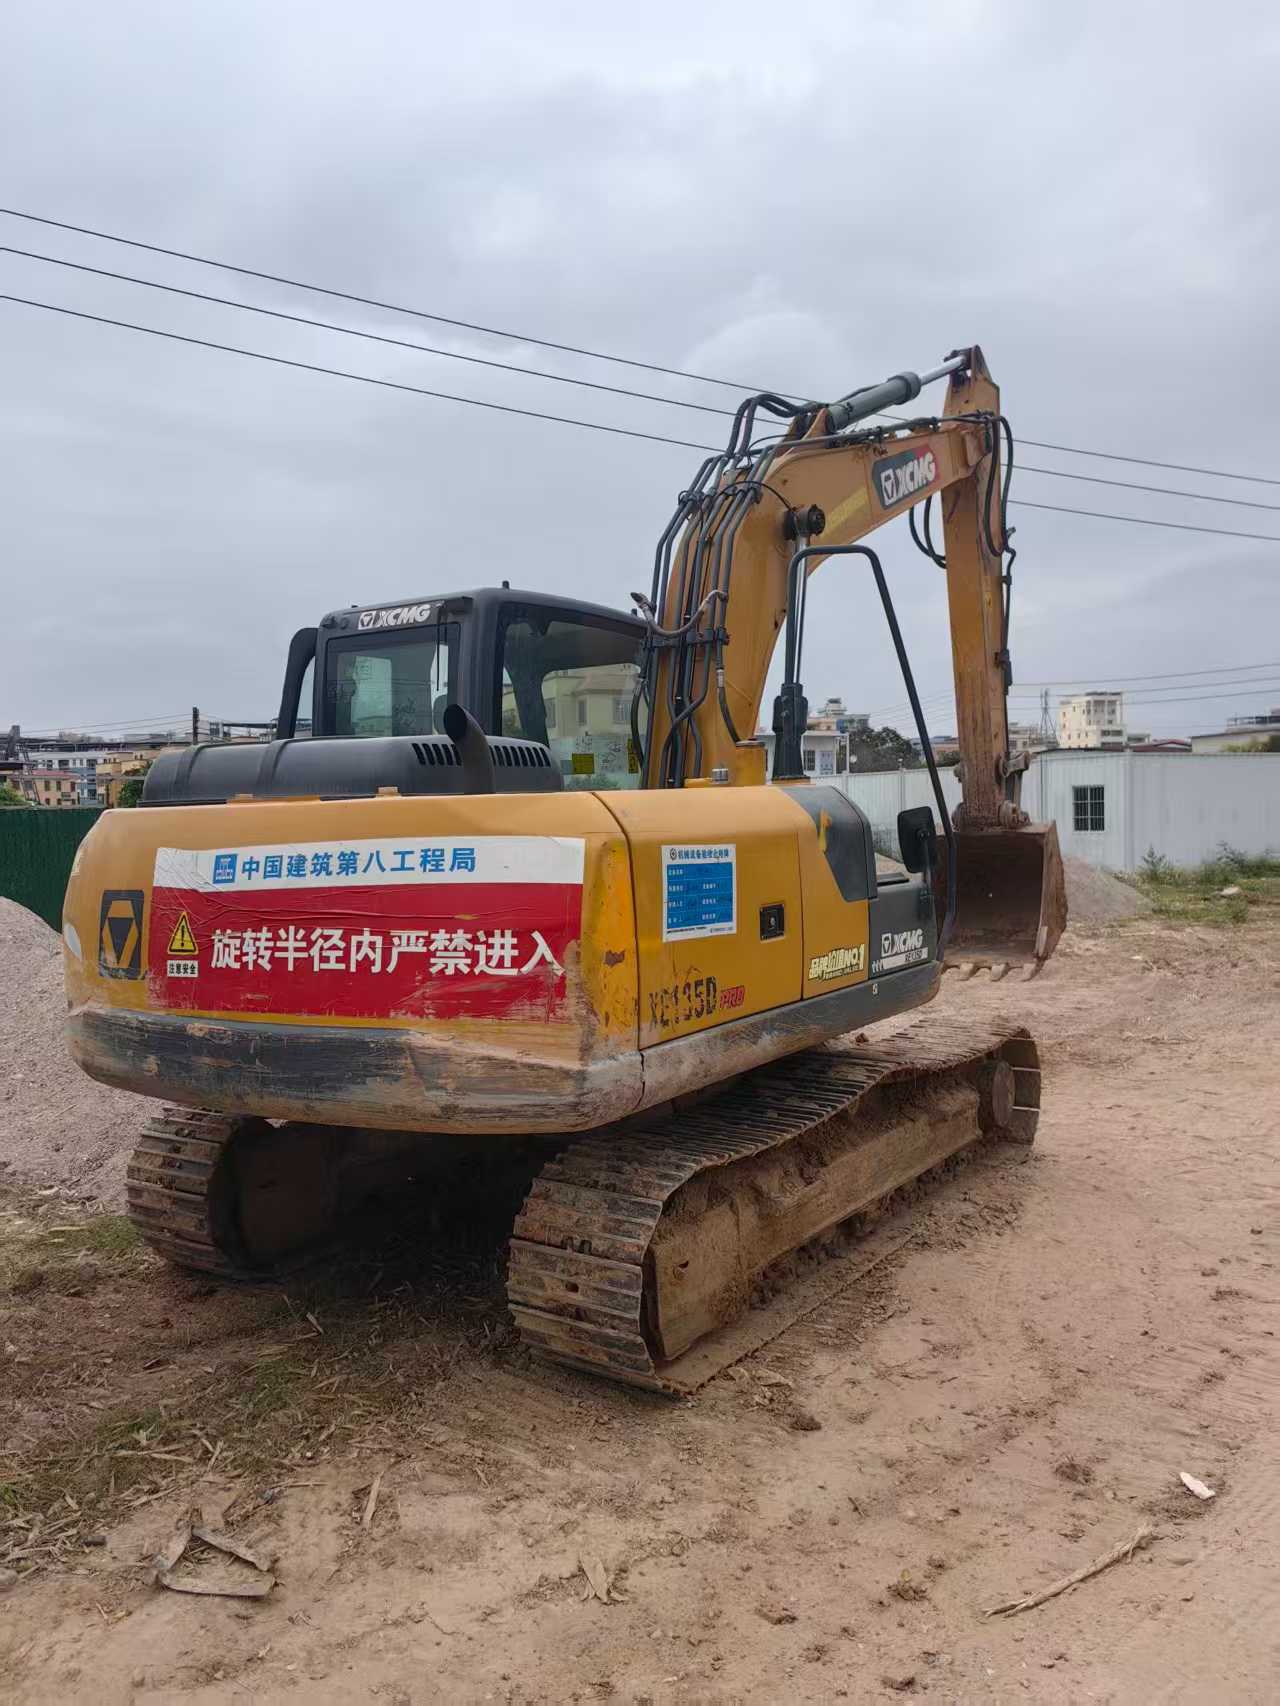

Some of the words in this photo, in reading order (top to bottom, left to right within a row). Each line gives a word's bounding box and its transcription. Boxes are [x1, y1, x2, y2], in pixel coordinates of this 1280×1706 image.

[896, 451, 936, 499] XCMG
[376, 603, 431, 627] XCMG
[241, 848, 476, 880] 中国建筑第八工程局
[211, 927, 565, 977] 旋转半径内严禁进入
[891, 929, 923, 955] XCMG
